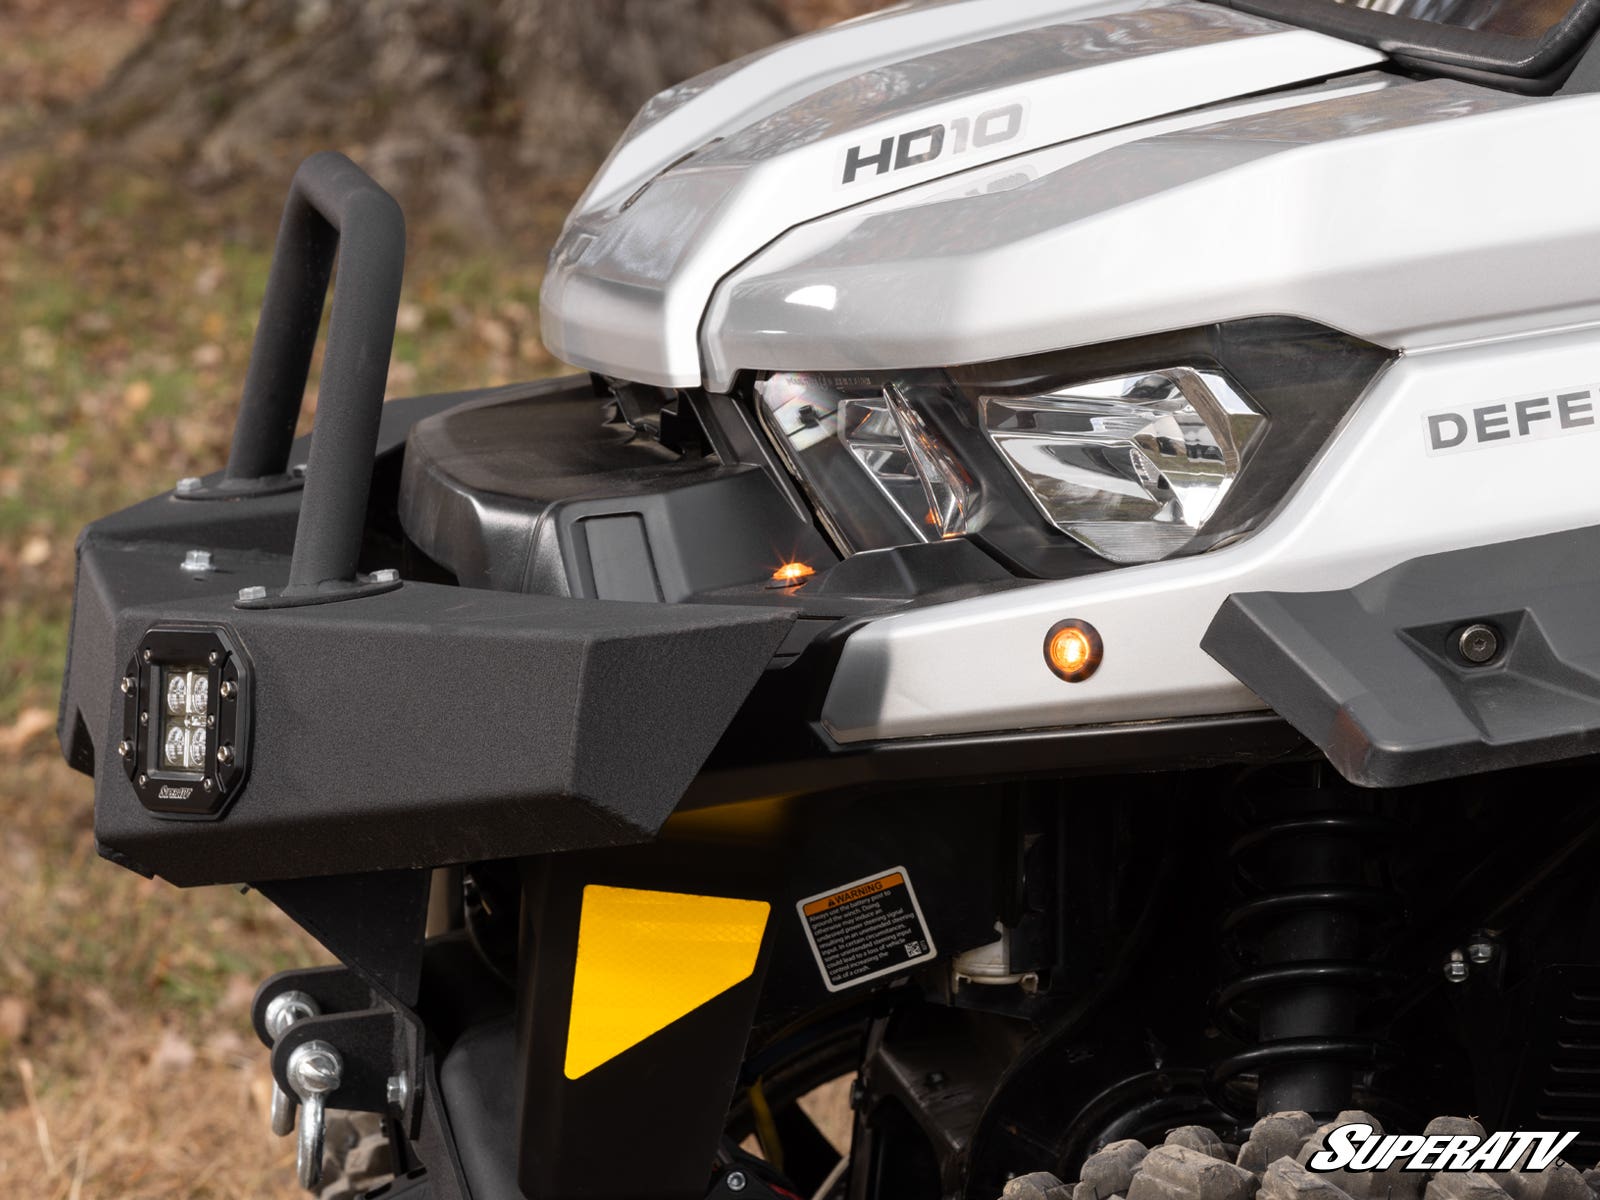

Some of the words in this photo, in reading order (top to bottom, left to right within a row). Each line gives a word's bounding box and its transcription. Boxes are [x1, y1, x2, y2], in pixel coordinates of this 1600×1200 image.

[842, 103, 1023, 184] HD10
[1428, 389, 1599, 451] DEFE
[835, 881, 883, 904] WARNING
[842, 919, 855, 927] may
